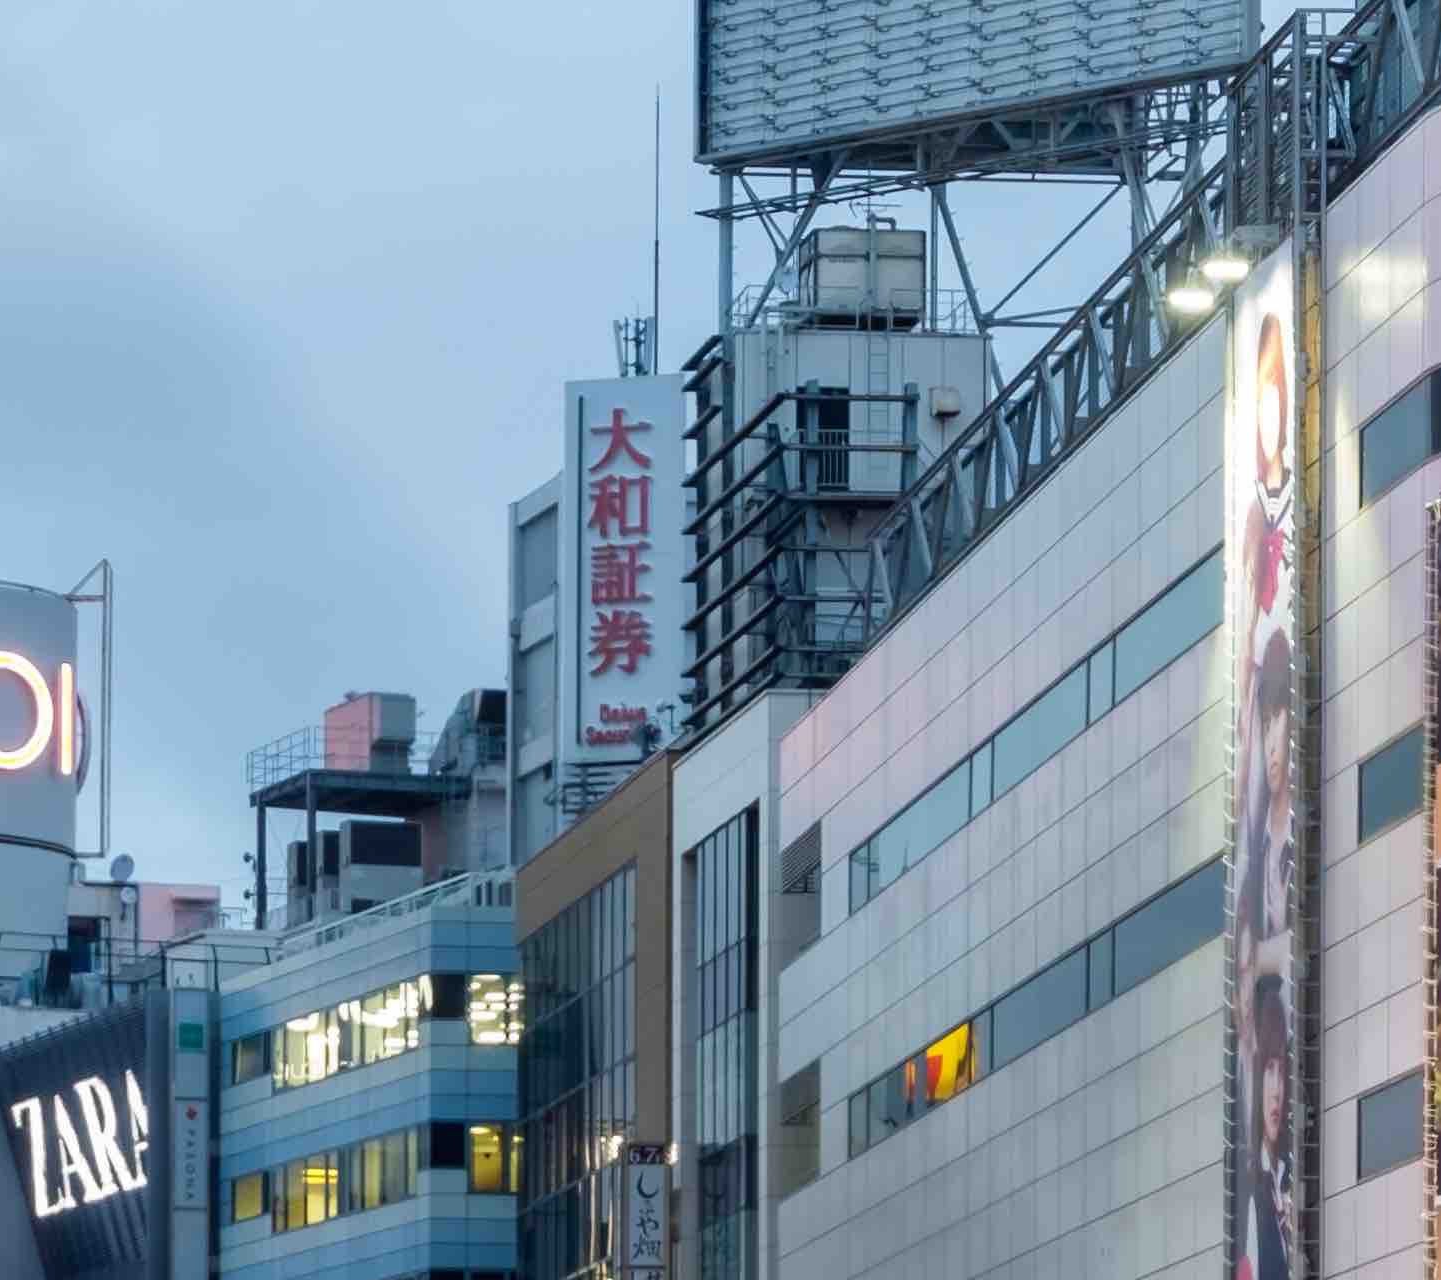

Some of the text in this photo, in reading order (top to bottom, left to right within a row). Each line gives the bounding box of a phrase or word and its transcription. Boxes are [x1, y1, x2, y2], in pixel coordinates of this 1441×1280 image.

[588, 407, 653, 679] 大和証券
[11, 1069, 149, 1218] ZARA
